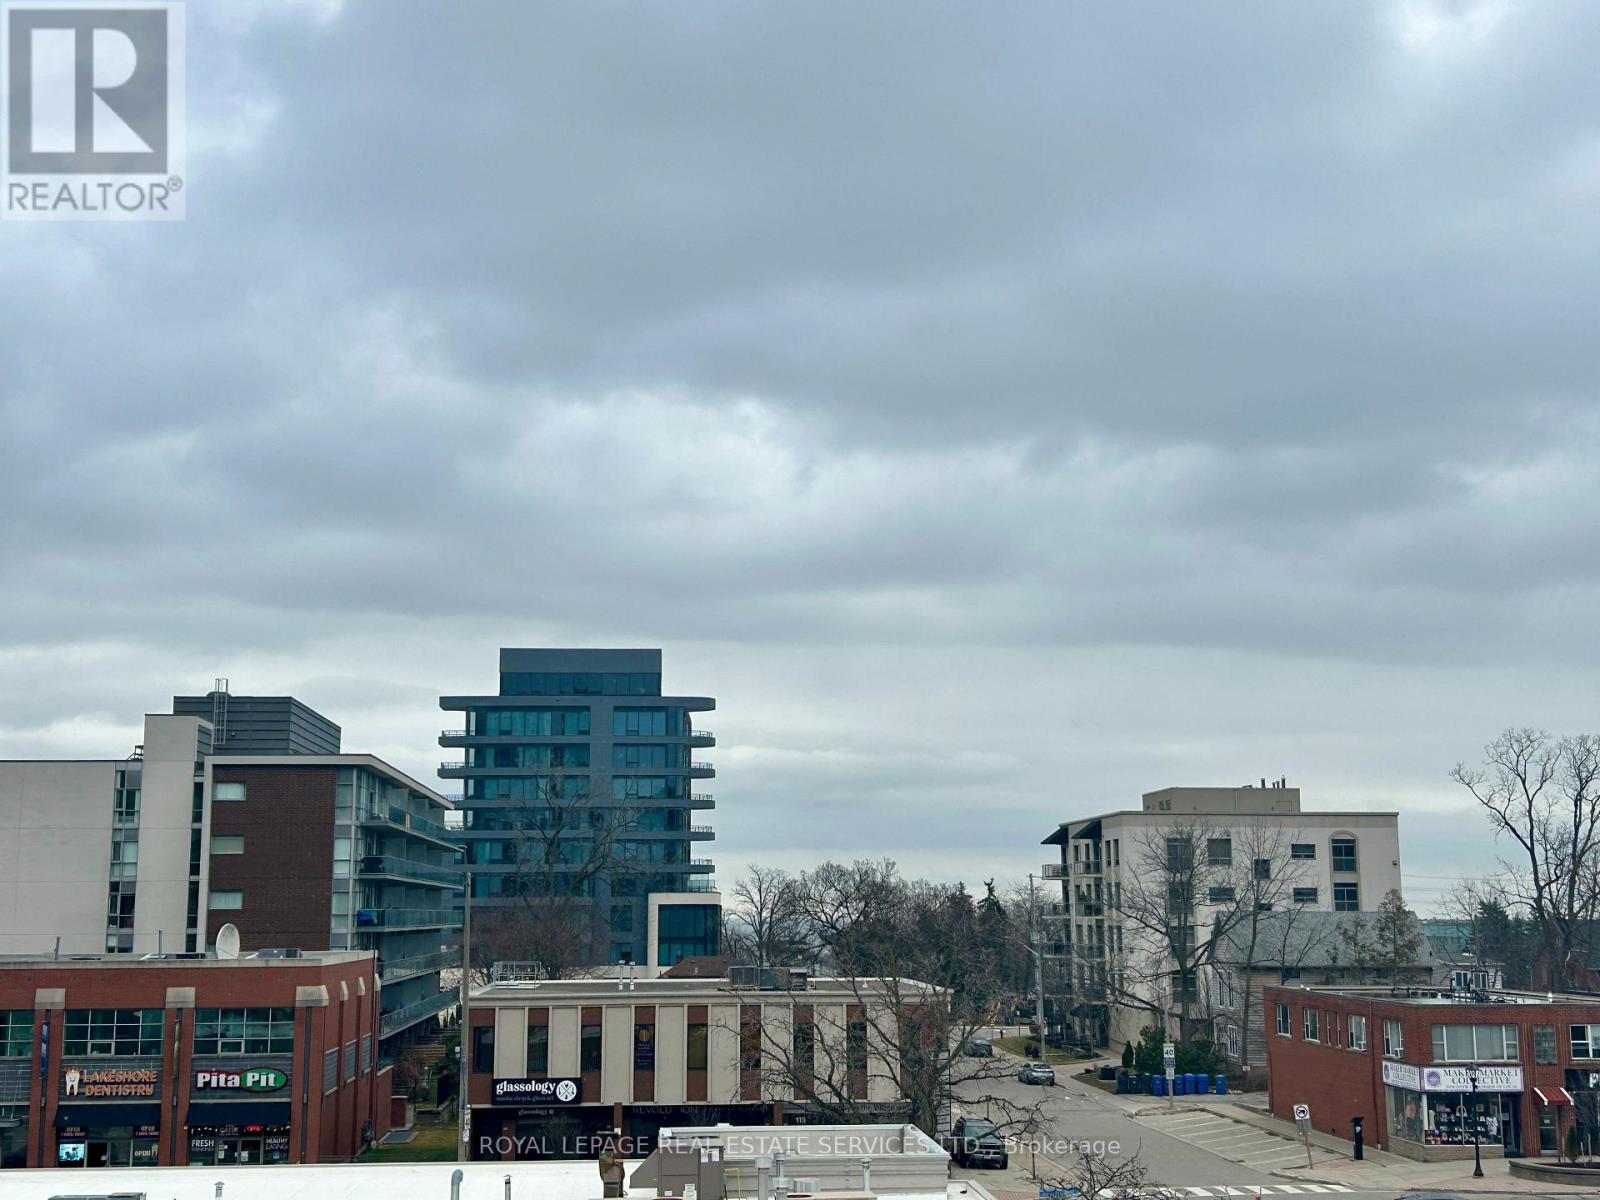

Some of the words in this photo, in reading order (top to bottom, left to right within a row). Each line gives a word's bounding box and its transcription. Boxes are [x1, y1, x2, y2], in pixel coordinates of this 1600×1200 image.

[83, 1069, 158, 1083] LAKESHORE
[1479, 1068, 1518, 1077] MARKET
[196, 1072, 241, 1088] Pita
[246, 1072, 276, 1087] Pit
[1451, 1076, 1512, 1084] COLECTIVE
[84, 1084, 154, 1097] DENTISTRY
[495, 1080, 556, 1095] glassology
[192, 1140, 214, 1148] FRESH
